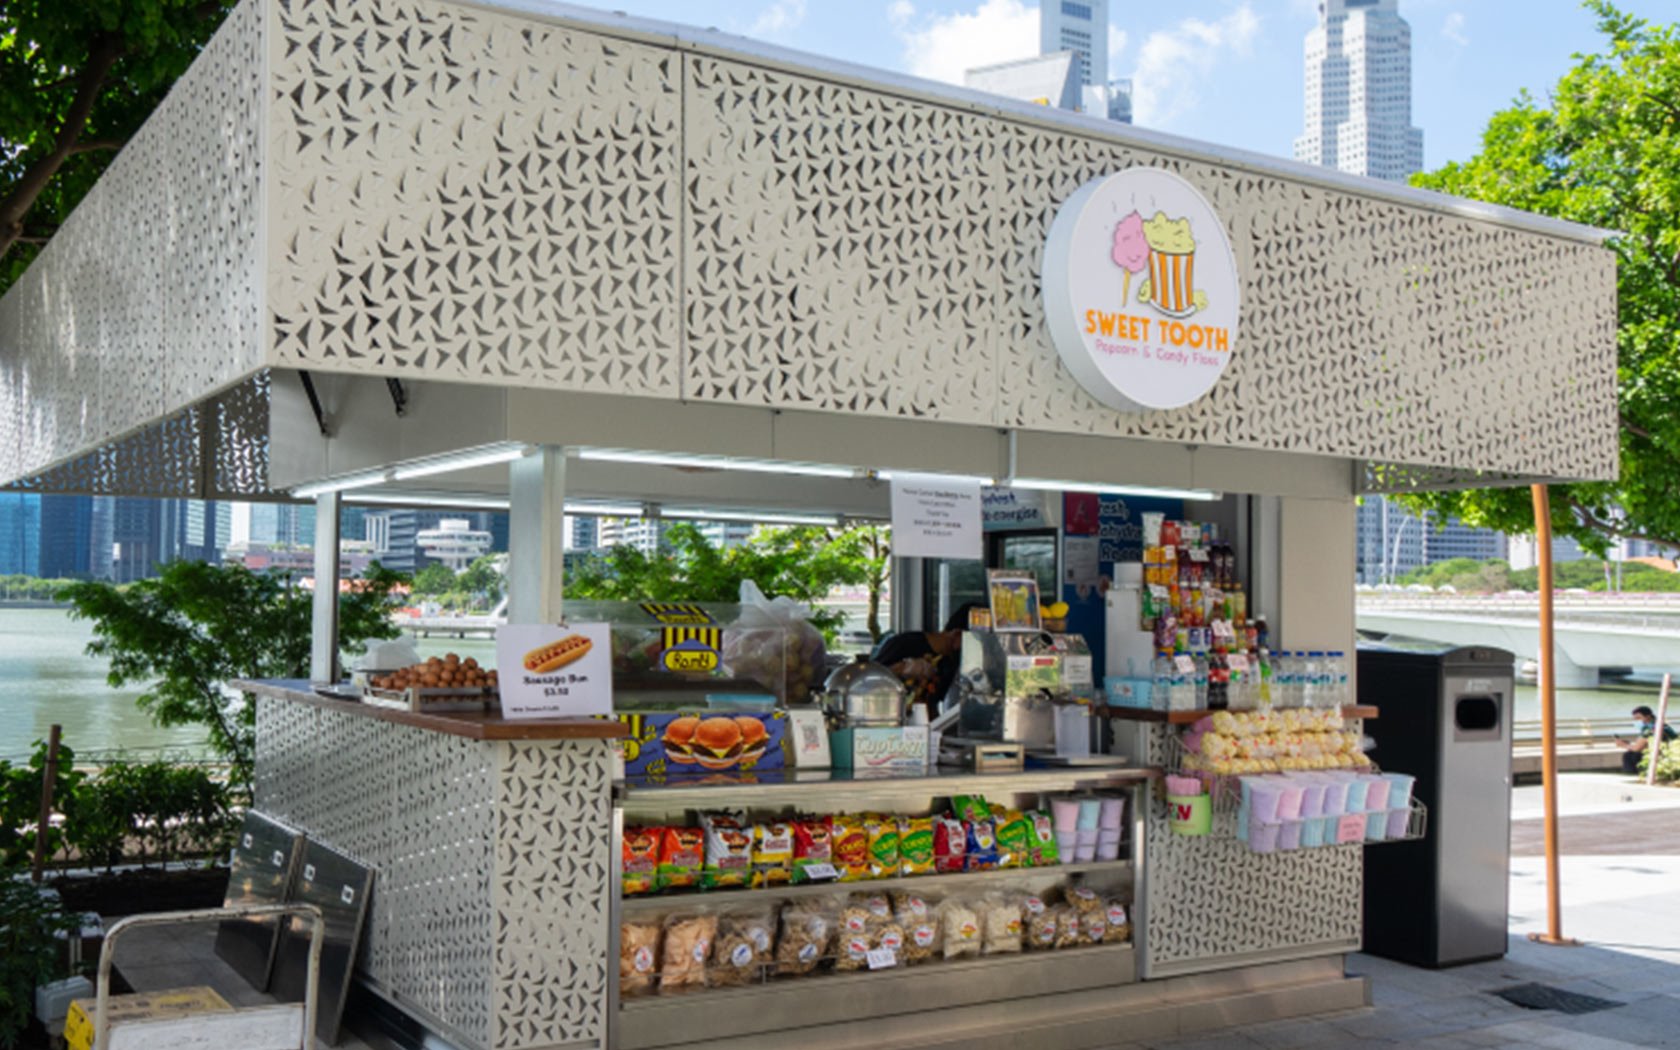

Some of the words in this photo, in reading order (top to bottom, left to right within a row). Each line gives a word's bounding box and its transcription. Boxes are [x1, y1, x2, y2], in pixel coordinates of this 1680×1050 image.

[1086, 309, 1151, 342] SWEET
[1157, 320, 1229, 352] TOOTH
[1095, 338, 1138, 356] Popcorn
[1143, 345, 1151, 358] &
[1156, 347, 1189, 365] Candy
[1193, 352, 1220, 366] Floss
[523, 675, 566, 686] Sausage
[568, 674, 588, 683] Bun
